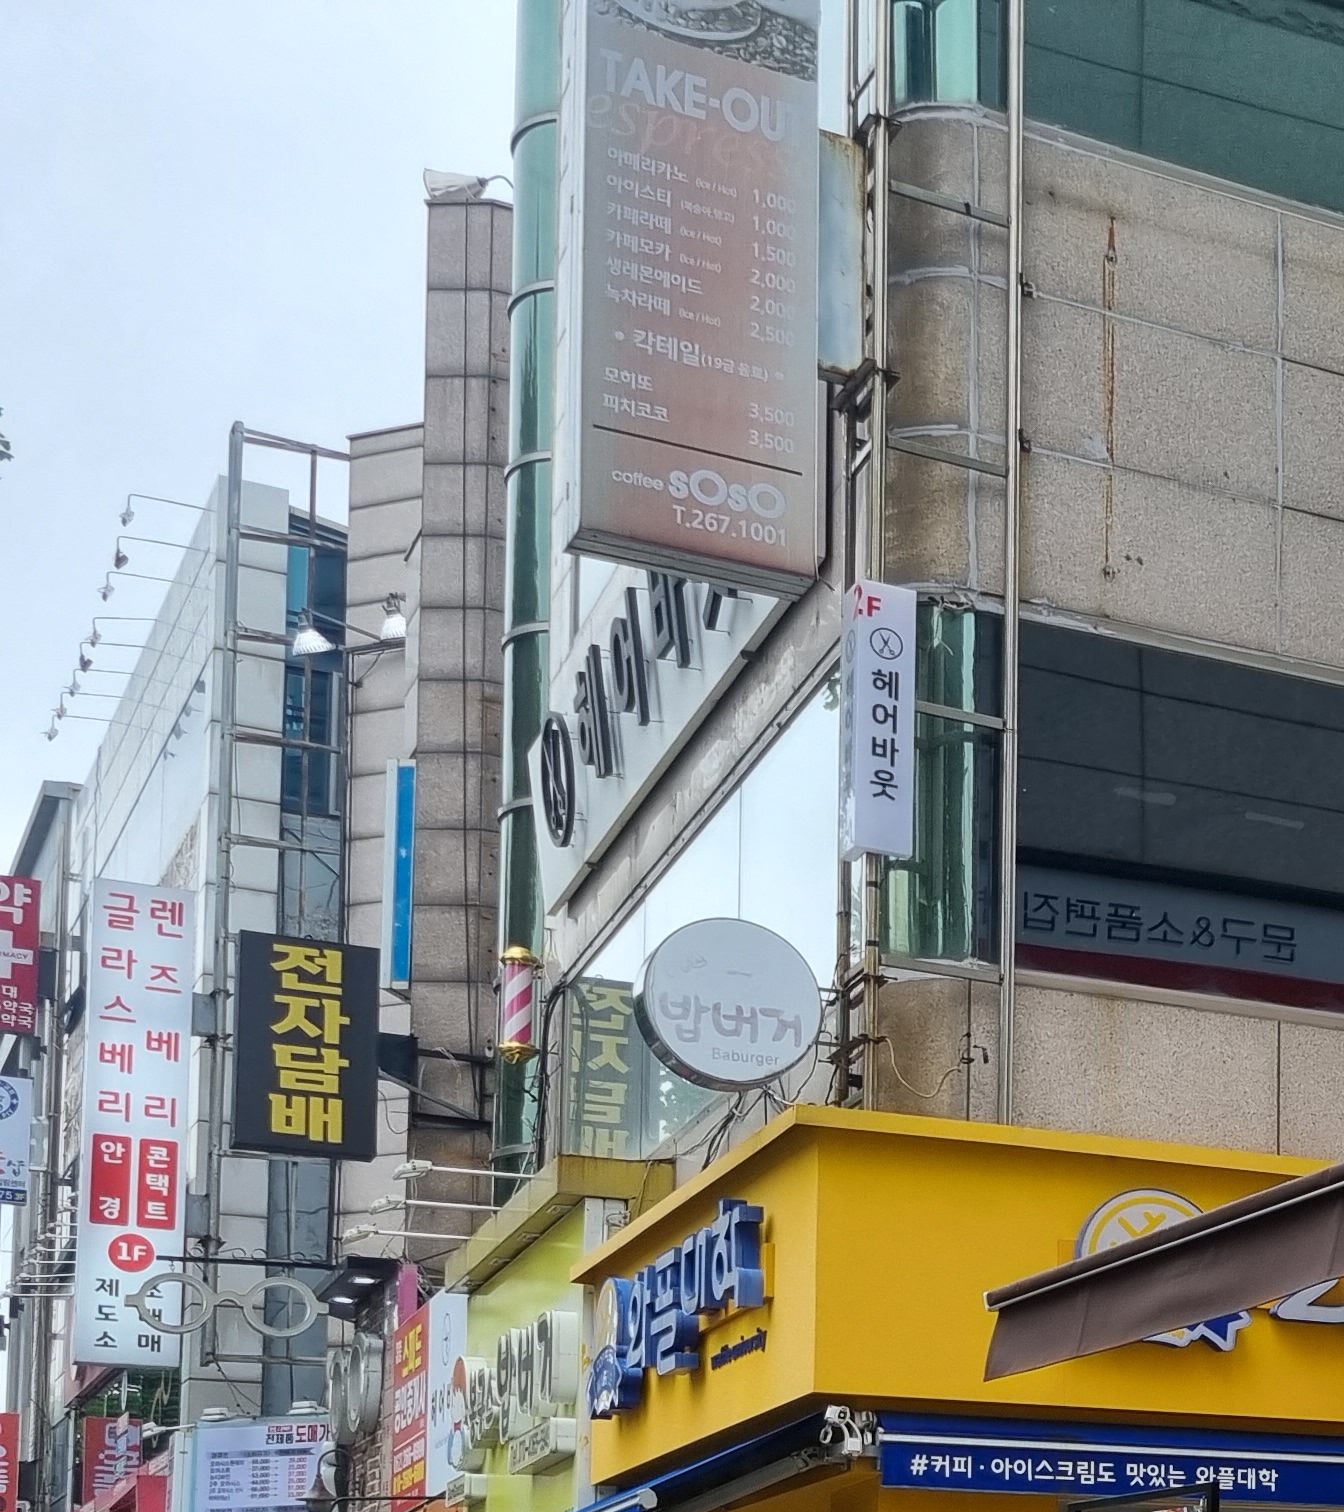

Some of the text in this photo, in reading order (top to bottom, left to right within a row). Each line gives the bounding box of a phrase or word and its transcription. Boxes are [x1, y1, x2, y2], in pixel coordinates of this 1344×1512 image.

[600, 48, 800, 143] TAKE-OU
[607, 148, 688, 183] 아메리카노
[607, 175, 672, 207] 아이스티
[607, 202, 672, 234] 카페라떼
[607, 229, 671, 262] 카페모카
[606, 257, 703, 295] 생레몬에이드
[605, 284, 671, 317] 녹차라떼
[603, 367, 653, 392] 모히또
[602, 393, 670, 423] 피치코코
[611, 469, 665, 491] coffee
[672, 504, 787, 547] T.267.1001
[869, 668, 900, 802] 헤어바웃
[97, 891, 141, 1124] 글라스베리
[144, 898, 185, 1128] 렌즈베리
[658, 992, 802, 1050] 밥버거
[269, 942, 351, 1145] 전자담배
[711, 1046, 780, 1067] Baburger
[98, 1141, 127, 1218] 안경
[144, 1145, 172, 1222] 콘택트
[117, 1244, 147, 1262] 1F
[627, 1198, 765, 1377] 와플대학
[94, 1331, 162, 1353] 소매
[991, 1455, 1117, 1486] 아이스크림도
[1125, 1461, 1186, 1489] 맛있는
[1195, 1463, 1279, 1493] 와플대학
